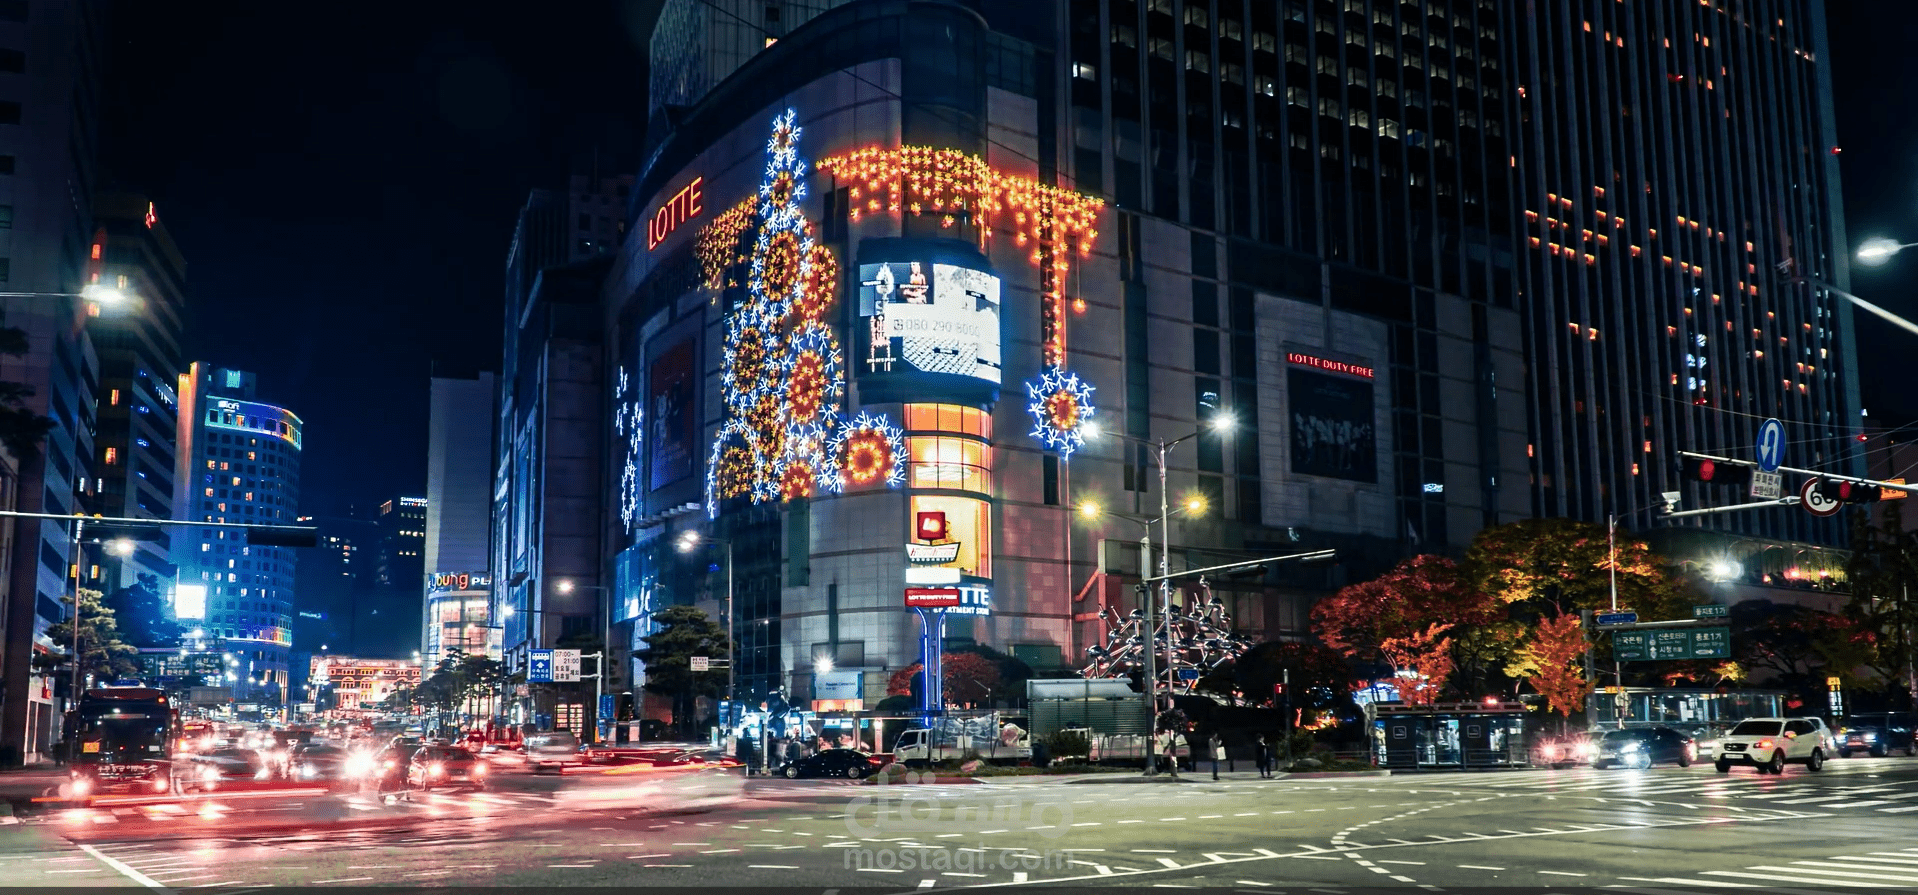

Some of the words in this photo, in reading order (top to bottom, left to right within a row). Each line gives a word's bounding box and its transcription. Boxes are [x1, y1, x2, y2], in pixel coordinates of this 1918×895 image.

[648, 176, 703, 251] LOTTE
[1289, 353, 1320, 367] LOTTE
[1323, 359, 1348, 372] DUTY
[1350, 365, 1373, 377] FREE
[432, 573, 469, 591] young
